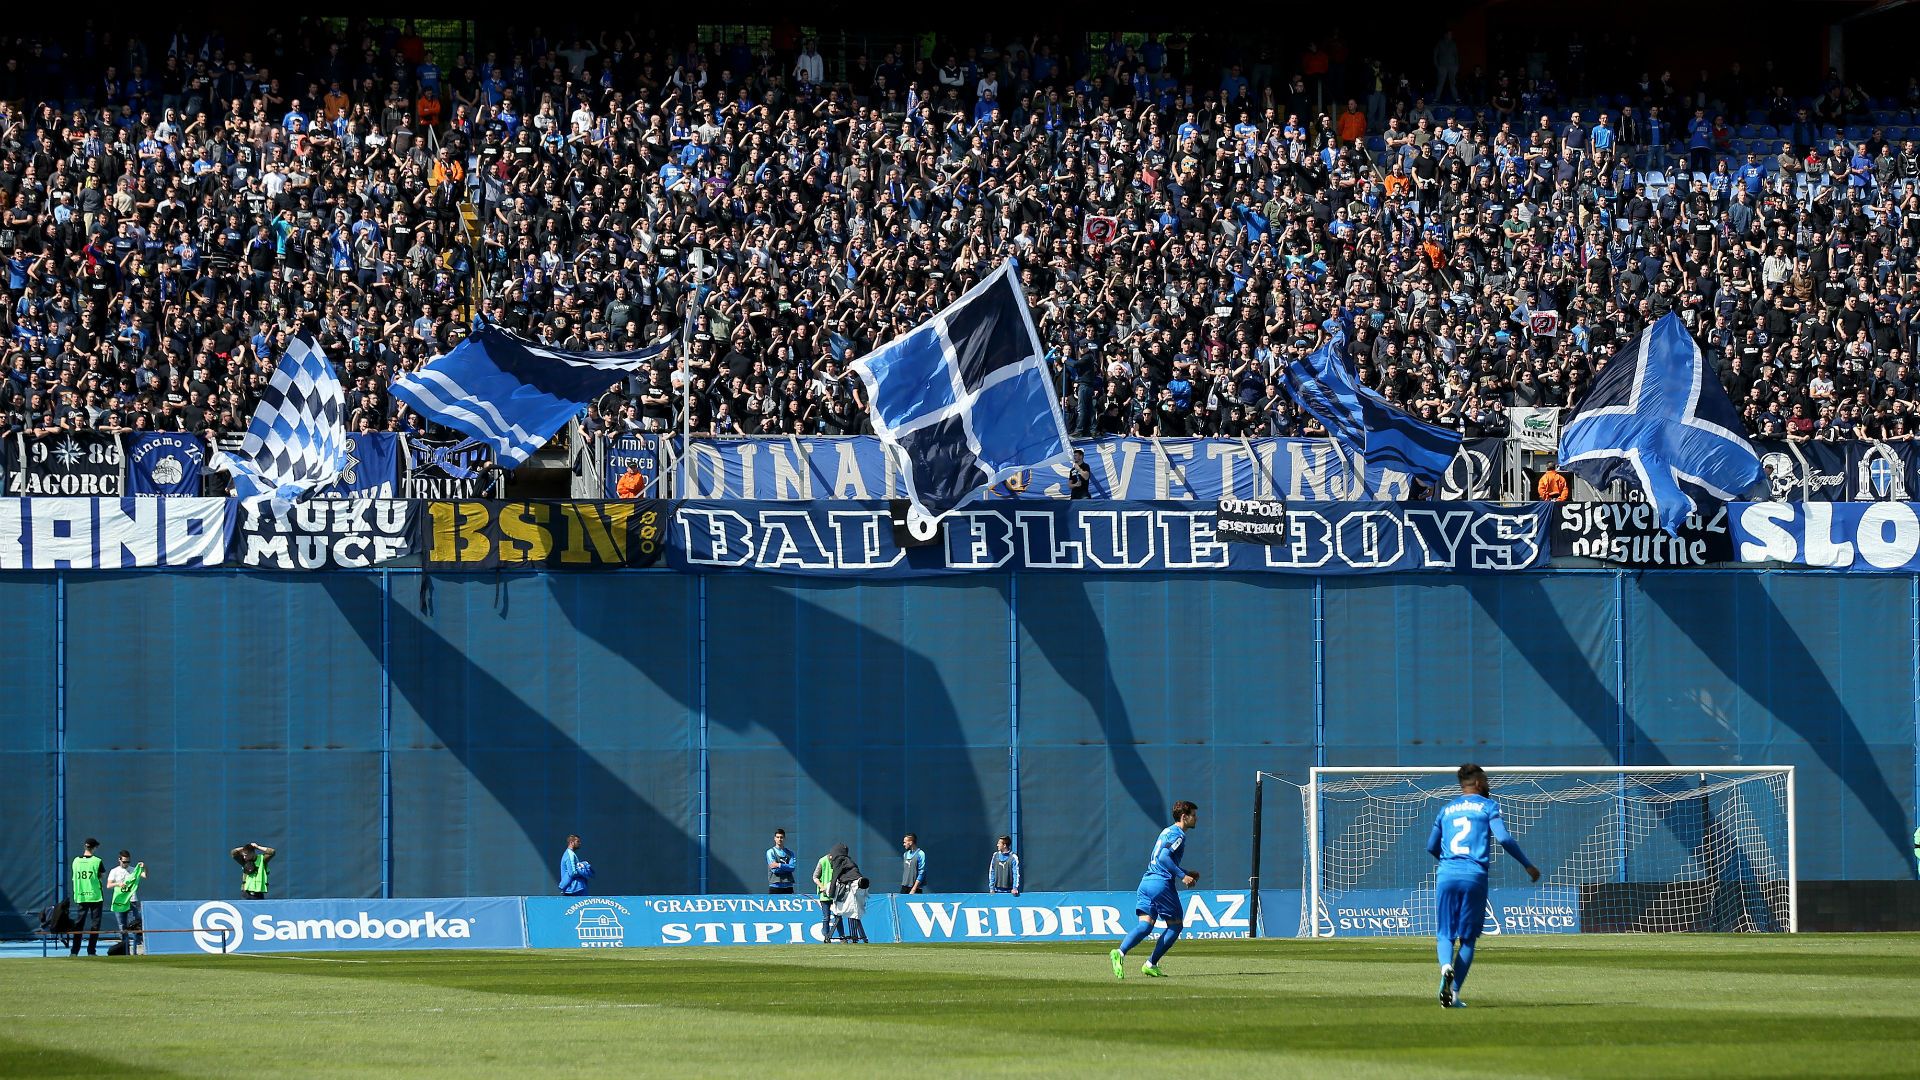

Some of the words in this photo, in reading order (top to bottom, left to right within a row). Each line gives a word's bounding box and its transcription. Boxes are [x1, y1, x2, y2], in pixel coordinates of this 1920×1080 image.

[1220, 500, 1284, 517] OTPOR
[427, 502, 635, 563] BSN
[1217, 520, 1285, 535] SISTEMU
[1740, 501, 1920, 568] SLO
[677, 508, 906, 569] BAD
[942, 508, 1230, 569] BLUE
[1265, 509, 1539, 571] BOYS
[243, 532, 408, 569] MUČE
[1450, 816, 1471, 855] 2
[1338, 907, 1410, 917] POLIKLINIKA
[1503, 906, 1574, 916] POLIKLINIKA
[1339, 917, 1411, 929] SUNCE
[1505, 916, 1576, 928] SUNCE
